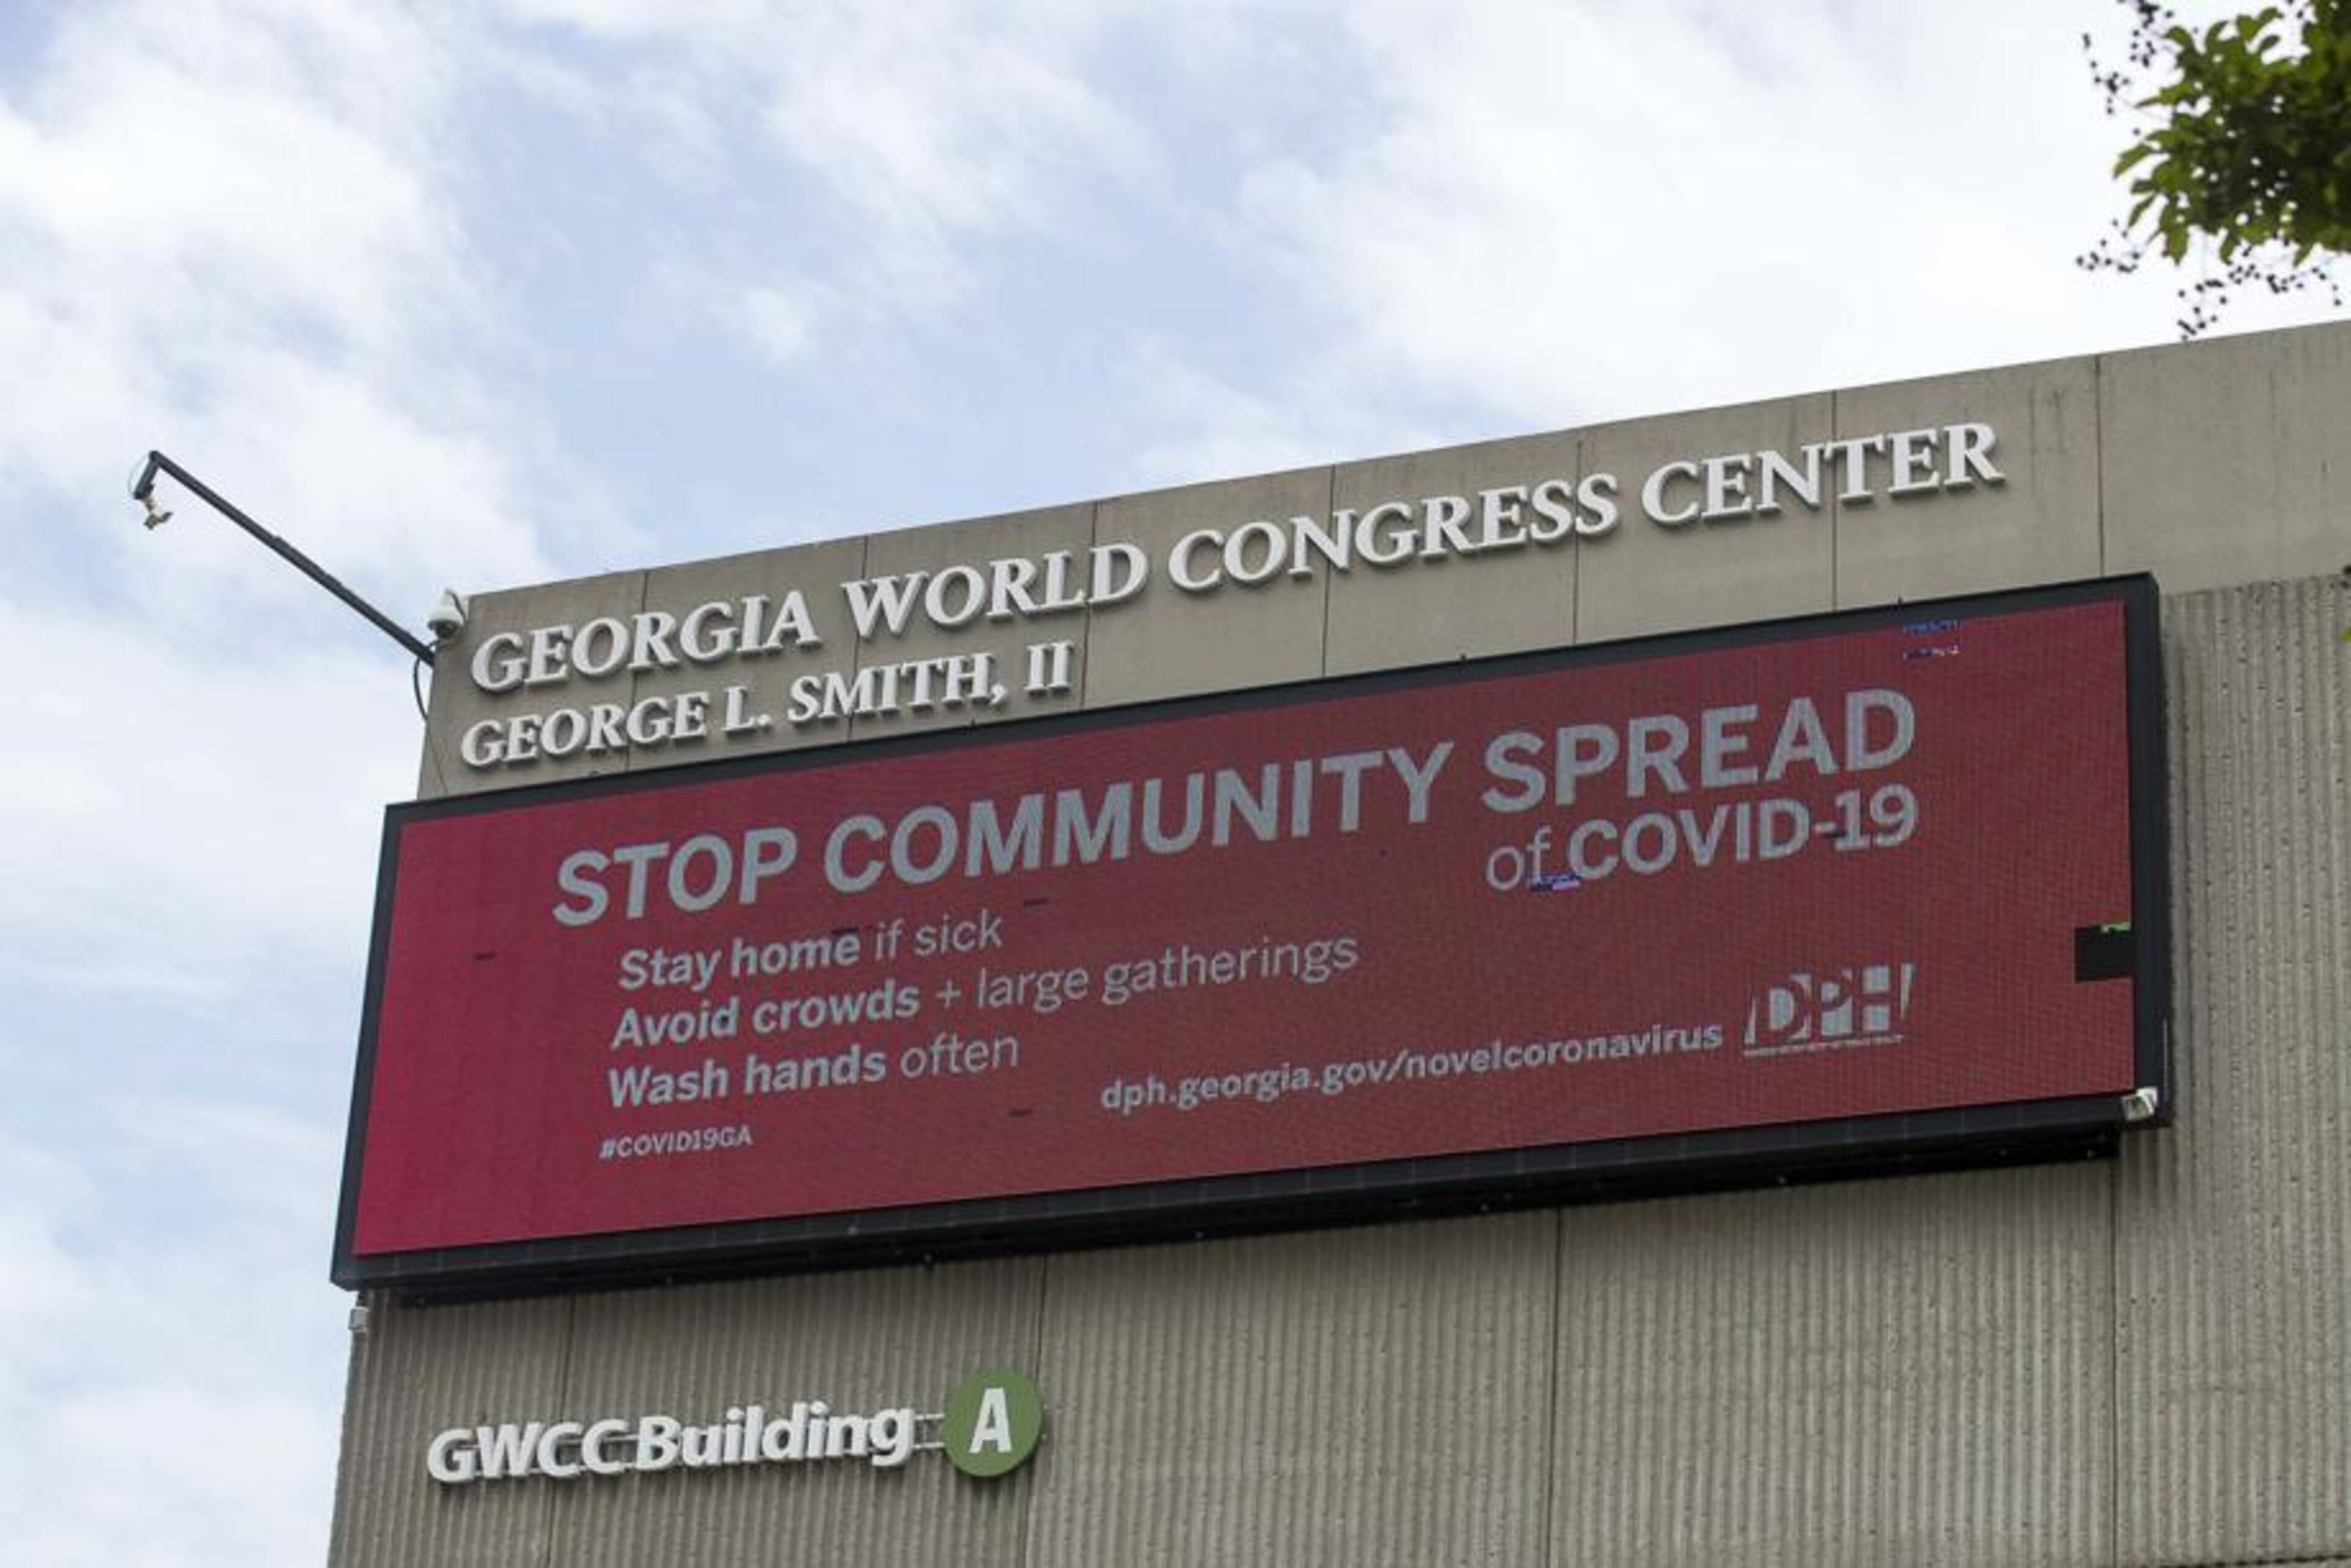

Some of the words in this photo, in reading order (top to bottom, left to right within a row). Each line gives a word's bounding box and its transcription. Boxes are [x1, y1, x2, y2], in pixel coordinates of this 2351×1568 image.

[470, 590, 816, 693] GEORGIA
[841, 542, 1148, 638] WORLD
[1168, 475, 1619, 592] CONGRESS
[1641, 422, 2006, 525] CENTER
[461, 693, 708, 768] GEORGE
[721, 687, 770, 732] L.
[787, 654, 1007, 721] SMITH,
[1026, 642, 1073, 693] II
[553, 827, 797, 927] STOP
[823, 741, 1454, 894] COMMUNITY
[1480, 689, 1917, 814] SPREAD
[1485, 827, 1551, 890] of
[1569, 784, 1918, 879] COVID-19
[611, 998, 740, 1052] Avoid
[752, 978, 920, 1035] crowds
[977, 966, 1090, 1014] large
[1102, 936, 1359, 1004] gatherings
[618, 948, 721, 992] Stay
[731, 931, 860, 978] home
[874, 921, 902, 960] if
[915, 909, 1003, 956] sick
[609, 1059, 727, 1108] Wash
[744, 1044, 887, 1096] hands
[900, 1035, 1020, 1079] often
[1101, 1021, 1724, 1116] dph.georgia.gov/novelcoronavirus
[599, 1125, 753, 1161] #COVID19GA
[426, 1419, 632, 1485] GWCC
[634, 1402, 915, 1469] Building
[969, 1386, 1014, 1455] A
